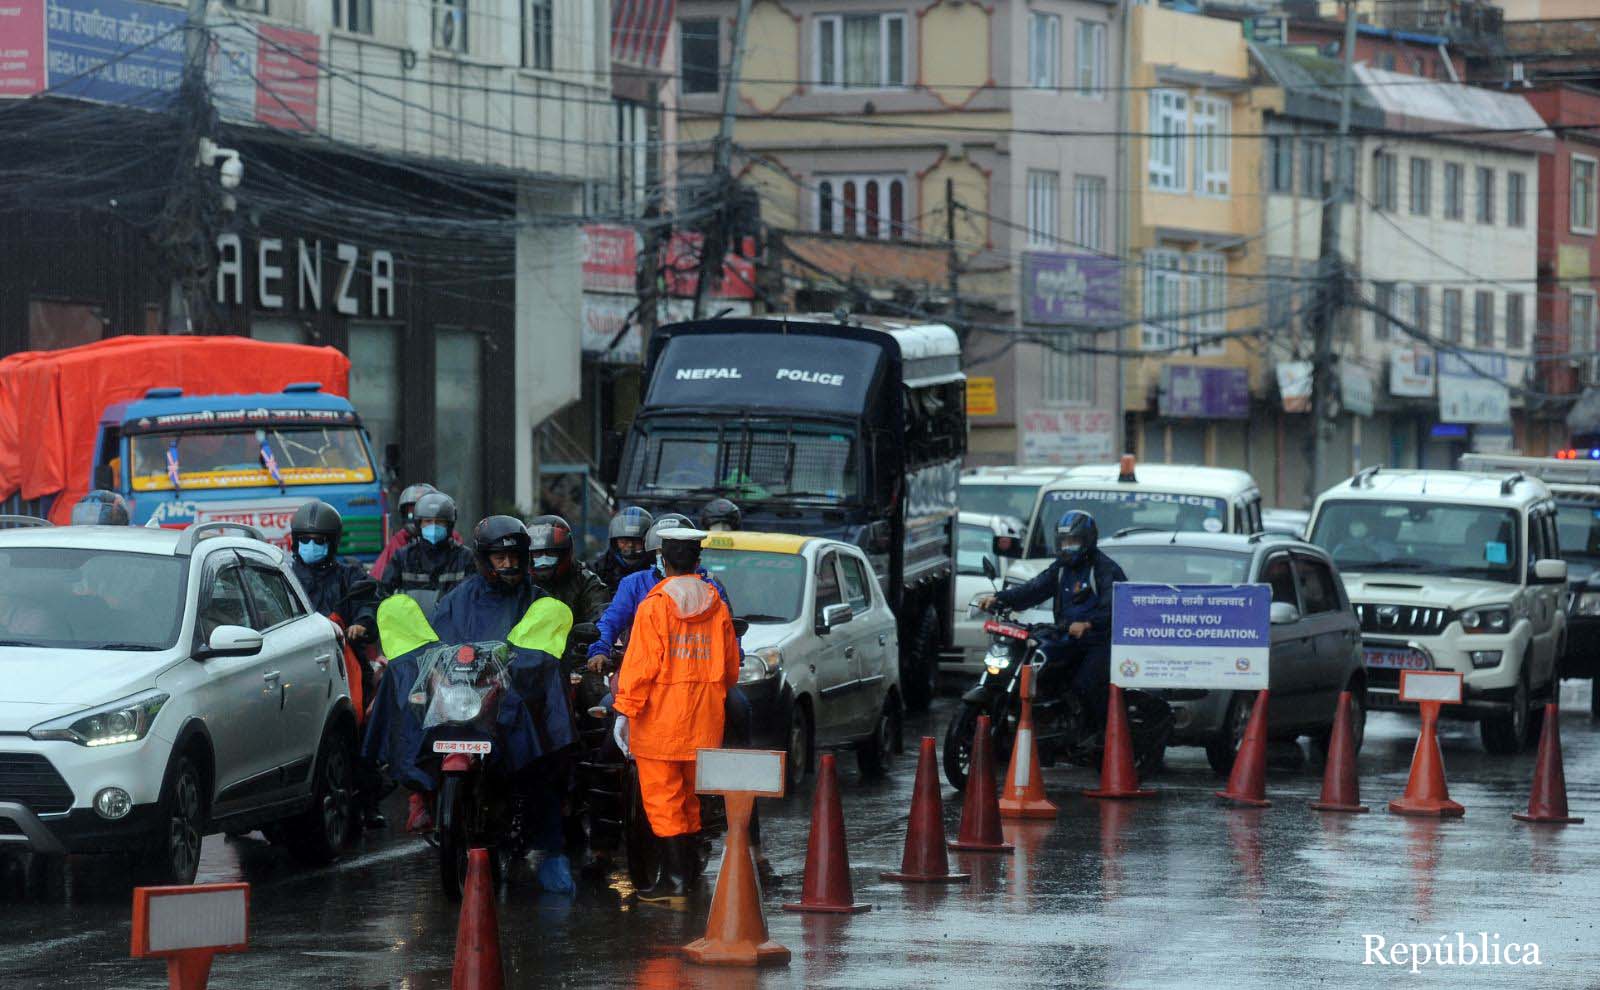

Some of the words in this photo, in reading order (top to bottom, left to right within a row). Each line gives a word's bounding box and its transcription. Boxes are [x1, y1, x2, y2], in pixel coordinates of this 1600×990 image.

[675, 368, 742, 380] NEPAL
[775, 368, 845, 386] POLICE
[1052, 491, 1131, 502] TOURIST
[1134, 493, 1218, 507] POLICE
[1161, 614, 1198, 625] THANK
[1199, 615, 1222, 625] YOU
[1122, 628, 1145, 638] FOR
[1146, 628, 1176, 639] YOUR
[1177, 629, 1259, 640] CO-OPERATION.
